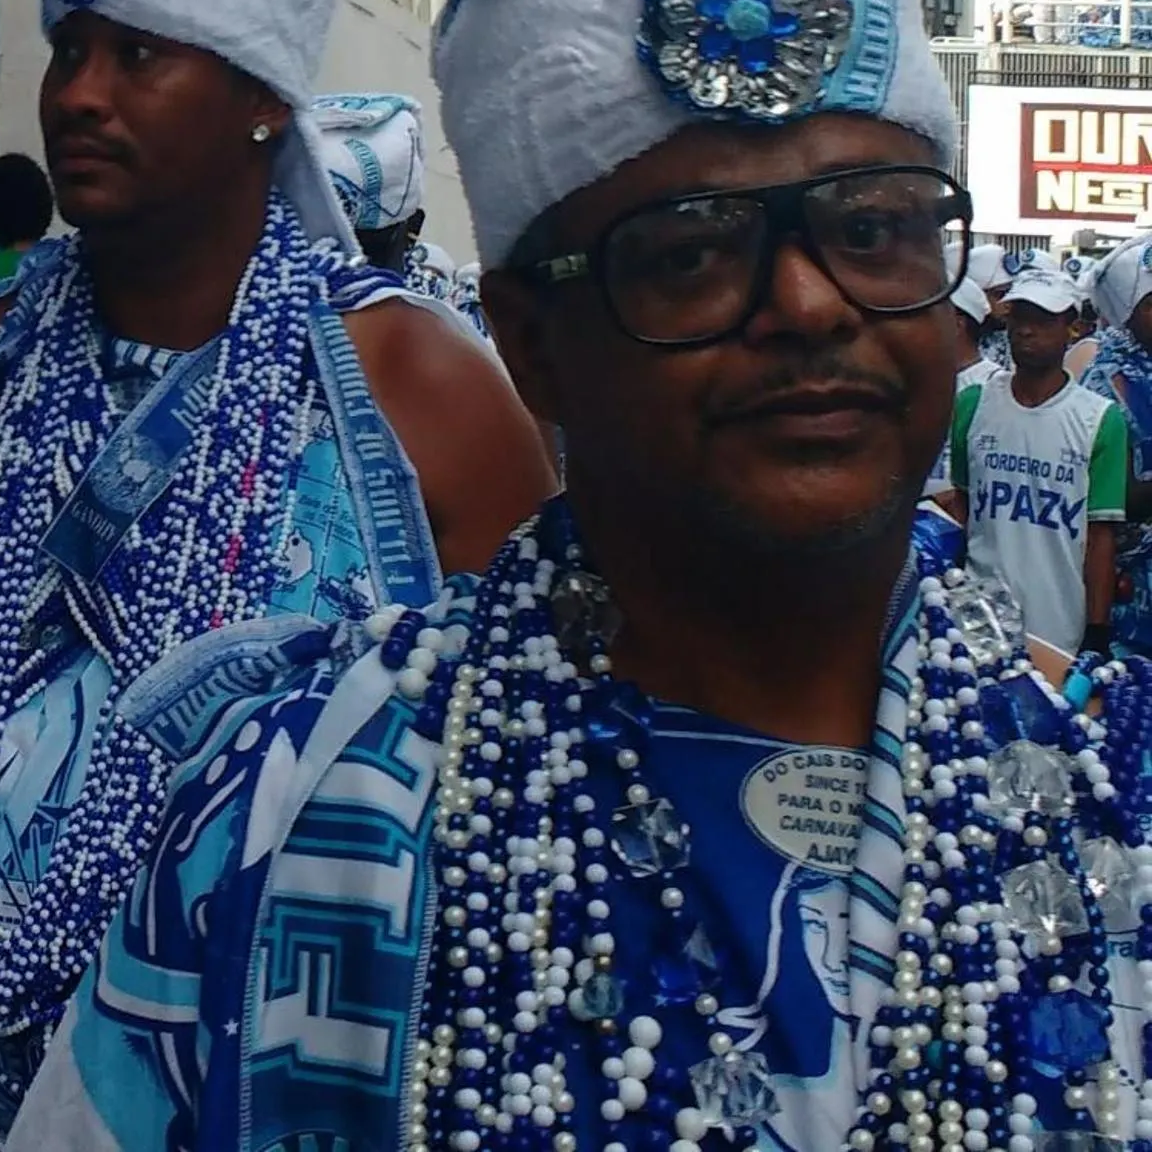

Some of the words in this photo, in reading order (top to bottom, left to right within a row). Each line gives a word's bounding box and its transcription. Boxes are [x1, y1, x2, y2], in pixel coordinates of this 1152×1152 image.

[1036, 169, 1152, 214] NEG
[1055, 463, 1075, 485] DA
[762, 762, 789, 784] DO
[792, 753, 835, 771] CAIS
[839, 754, 866, 772] DO
[804, 774, 850, 793] SINCE
[777, 792, 824, 812] PARA
[829, 799, 842, 814] O
